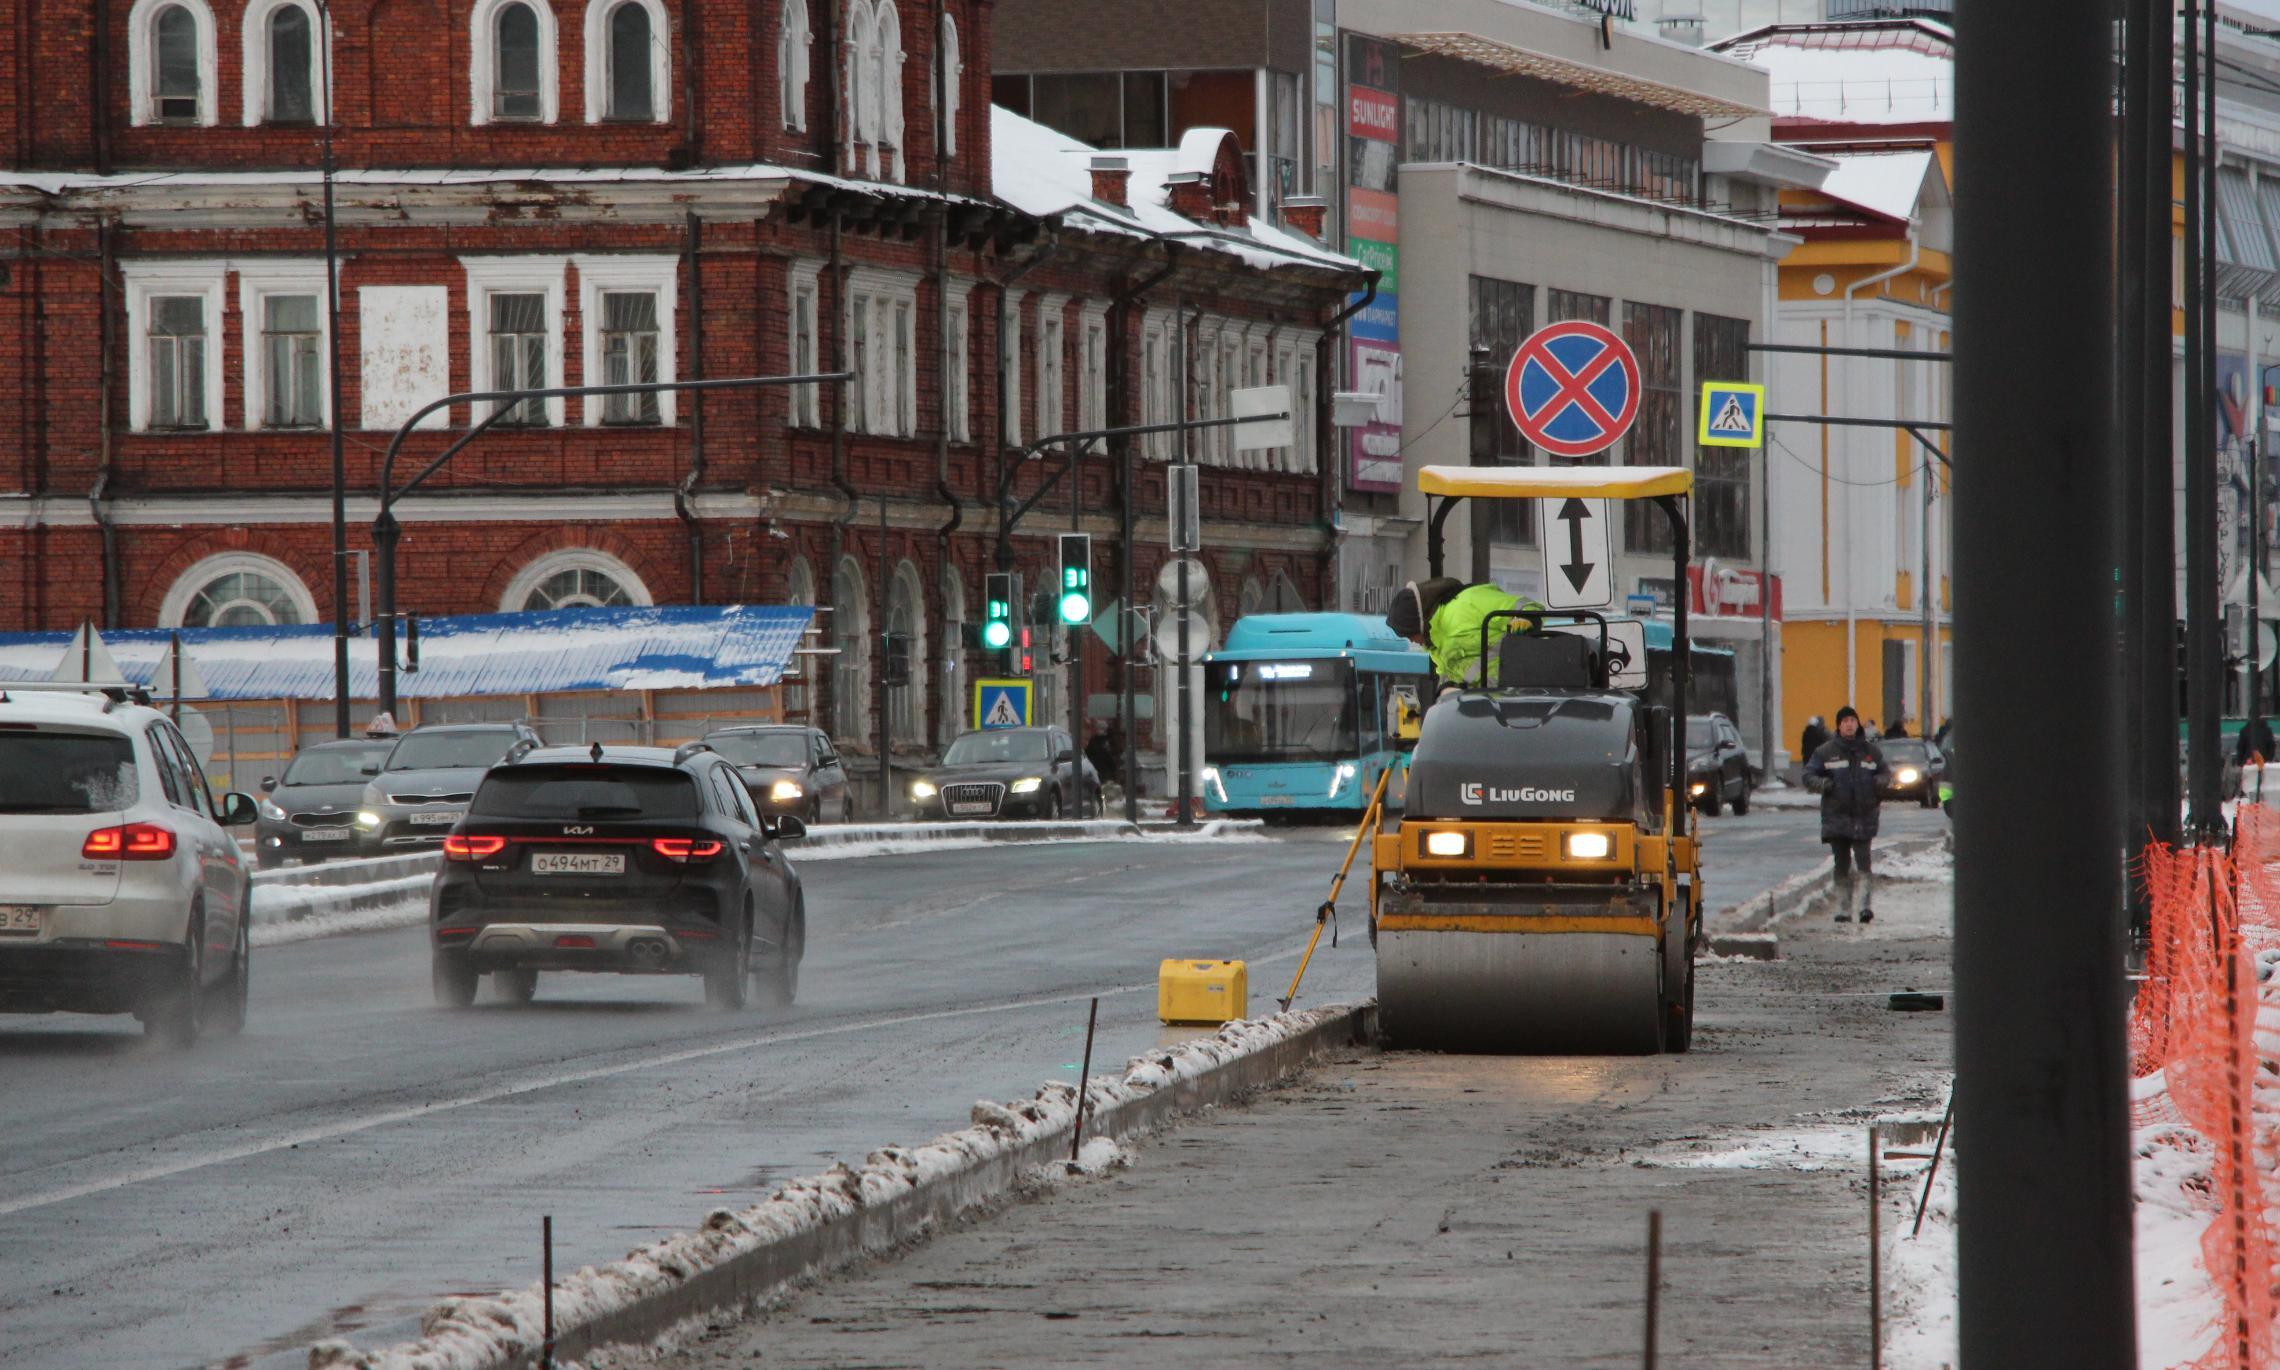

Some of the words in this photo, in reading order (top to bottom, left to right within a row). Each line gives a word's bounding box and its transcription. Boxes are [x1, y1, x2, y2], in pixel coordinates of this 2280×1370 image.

[1353, 99, 1395, 131] SUNLIGHT
[1064, 568, 1087, 587] 31
[15, 909, 33, 922] 29
